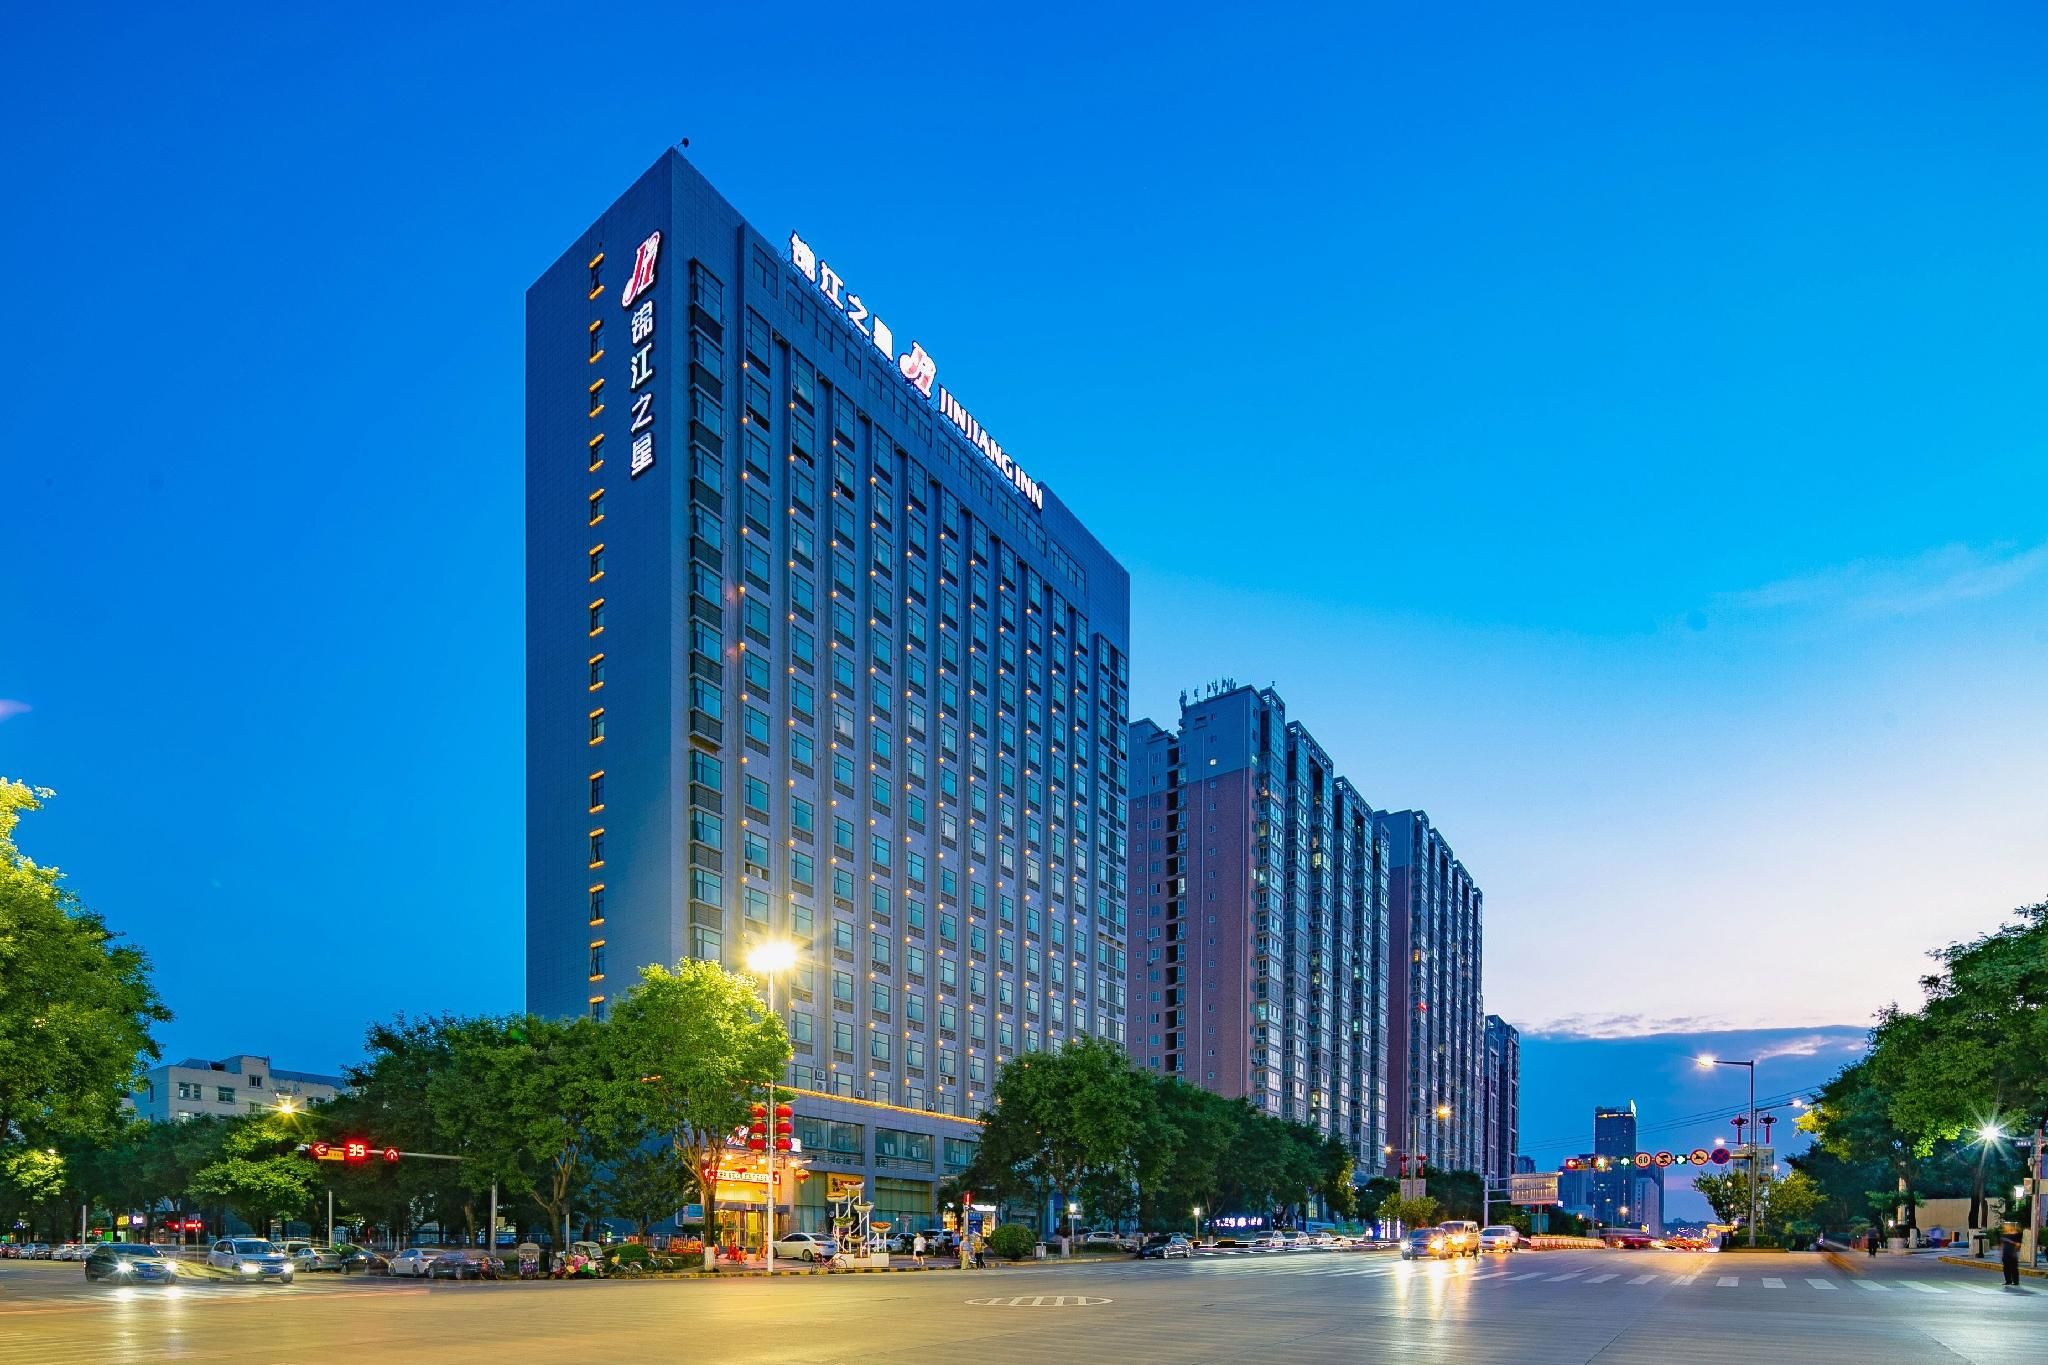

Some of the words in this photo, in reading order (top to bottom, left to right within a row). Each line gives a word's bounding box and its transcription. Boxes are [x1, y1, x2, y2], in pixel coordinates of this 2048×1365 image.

[791, 231, 894, 362] 锦江之
[630, 300, 653, 477] 锦江之星
[940, 387, 1013, 480] JINJIANG
[1014, 463, 1043, 510] INN
[1638, 1155, 1649, 1164] 60
